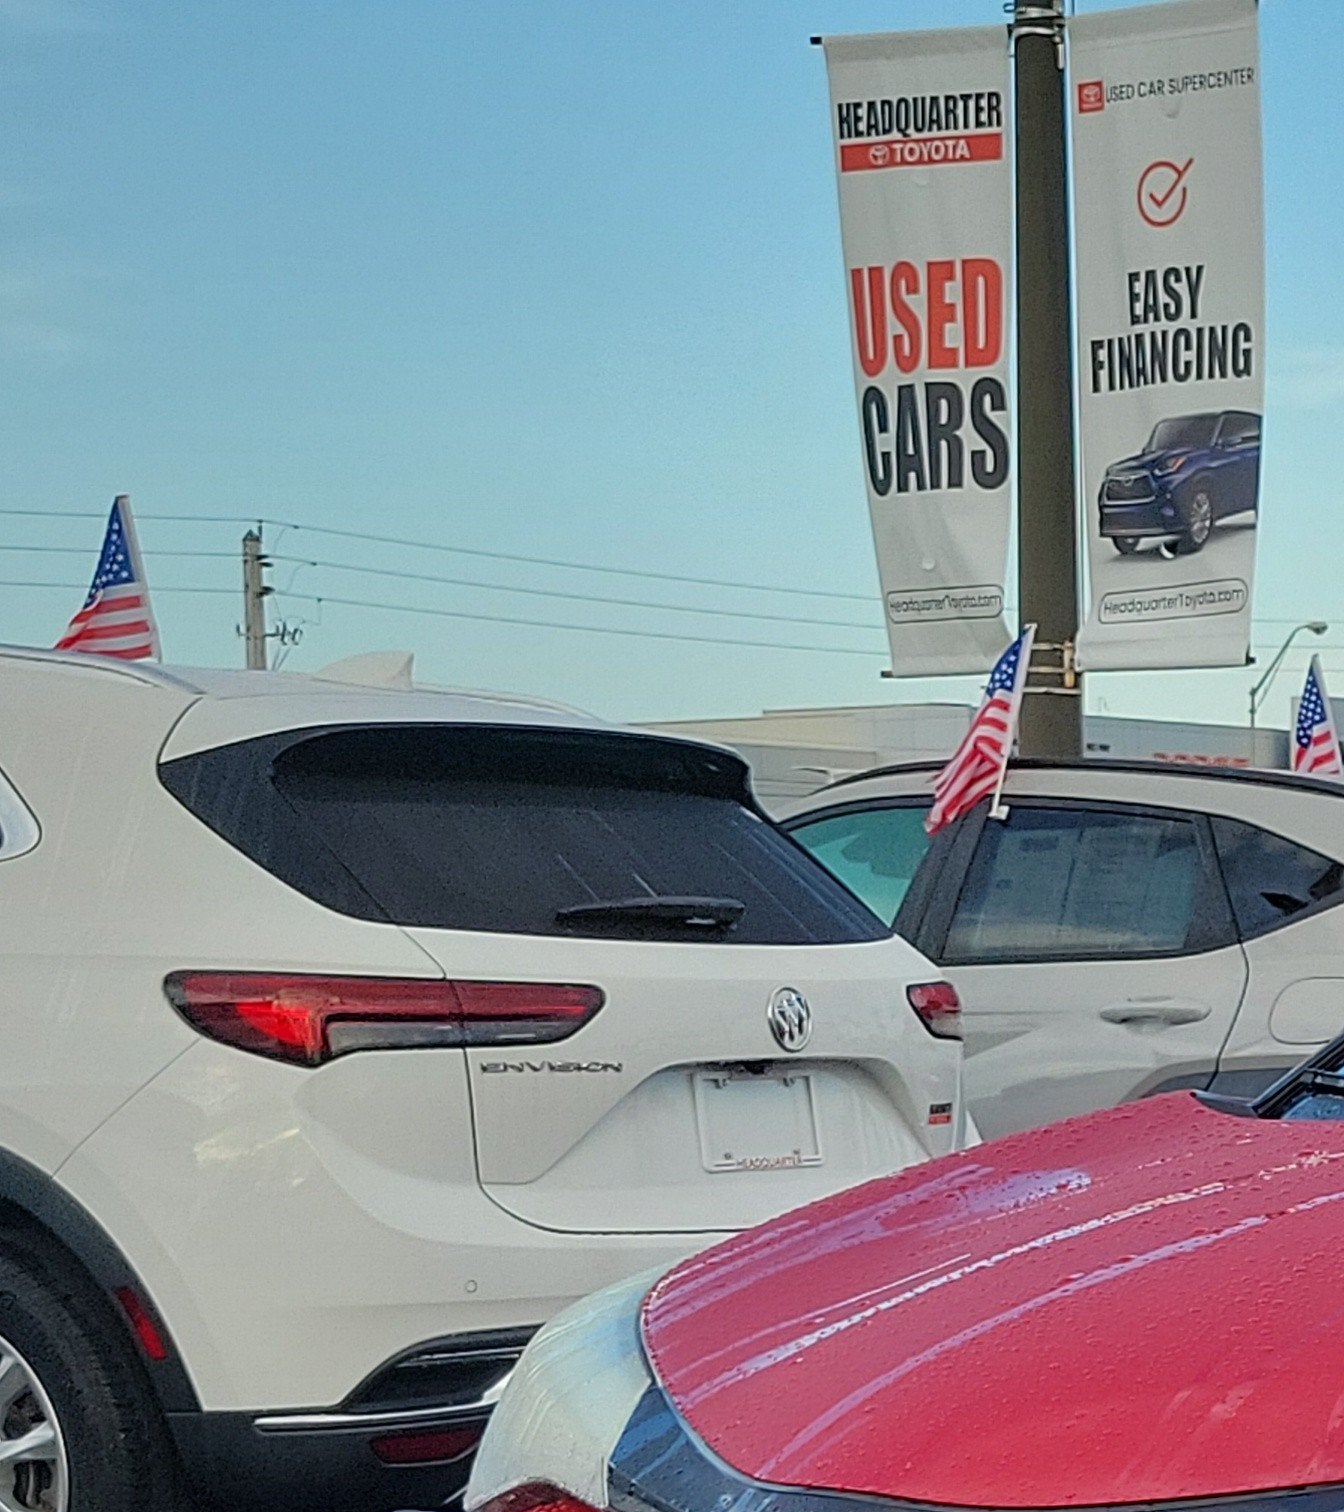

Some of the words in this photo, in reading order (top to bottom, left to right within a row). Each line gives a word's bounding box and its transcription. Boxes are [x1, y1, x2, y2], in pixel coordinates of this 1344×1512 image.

[838, 91, 1002, 139] HEADQUARTER
[1106, 84, 1135, 103] USED
[1138, 79, 1165, 98] CAR
[1169, 67, 1255, 95] SUPERCENTER
[890, 139, 970, 163] TOYOTA
[851, 259, 1003, 378] USED
[1128, 265, 1204, 326] EASY
[1091, 322, 1252, 393] FINANCING
[863, 377, 1010, 496] CARS
